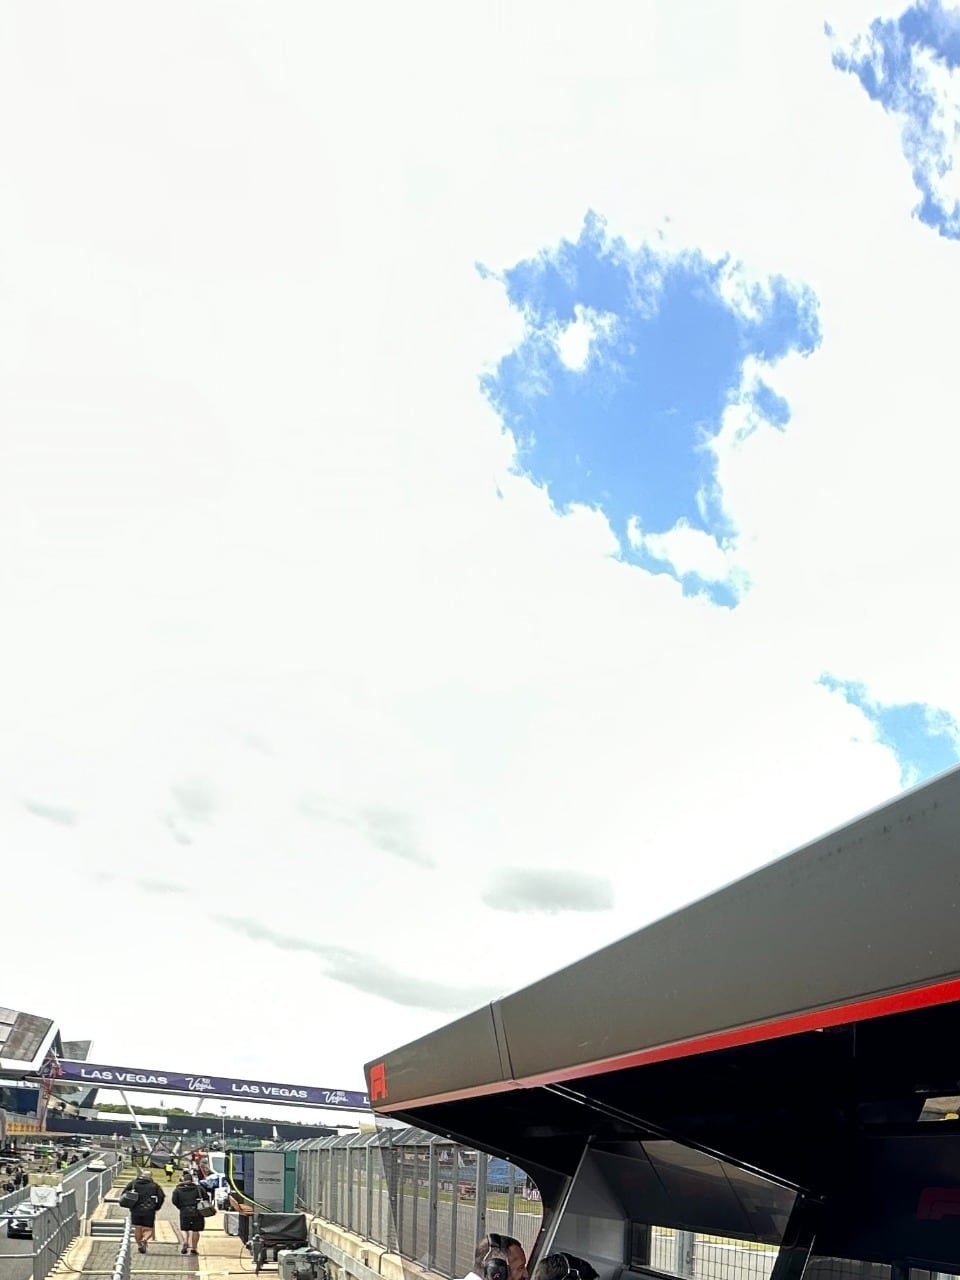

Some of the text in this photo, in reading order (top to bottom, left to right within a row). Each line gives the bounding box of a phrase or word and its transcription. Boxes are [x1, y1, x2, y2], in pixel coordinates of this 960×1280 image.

[81, 1069, 113, 1080] LAS
[115, 1072, 168, 1085] VEGAS
[232, 1083, 259, 1094] LAS
[262, 1086, 308, 1098] VEGAS
